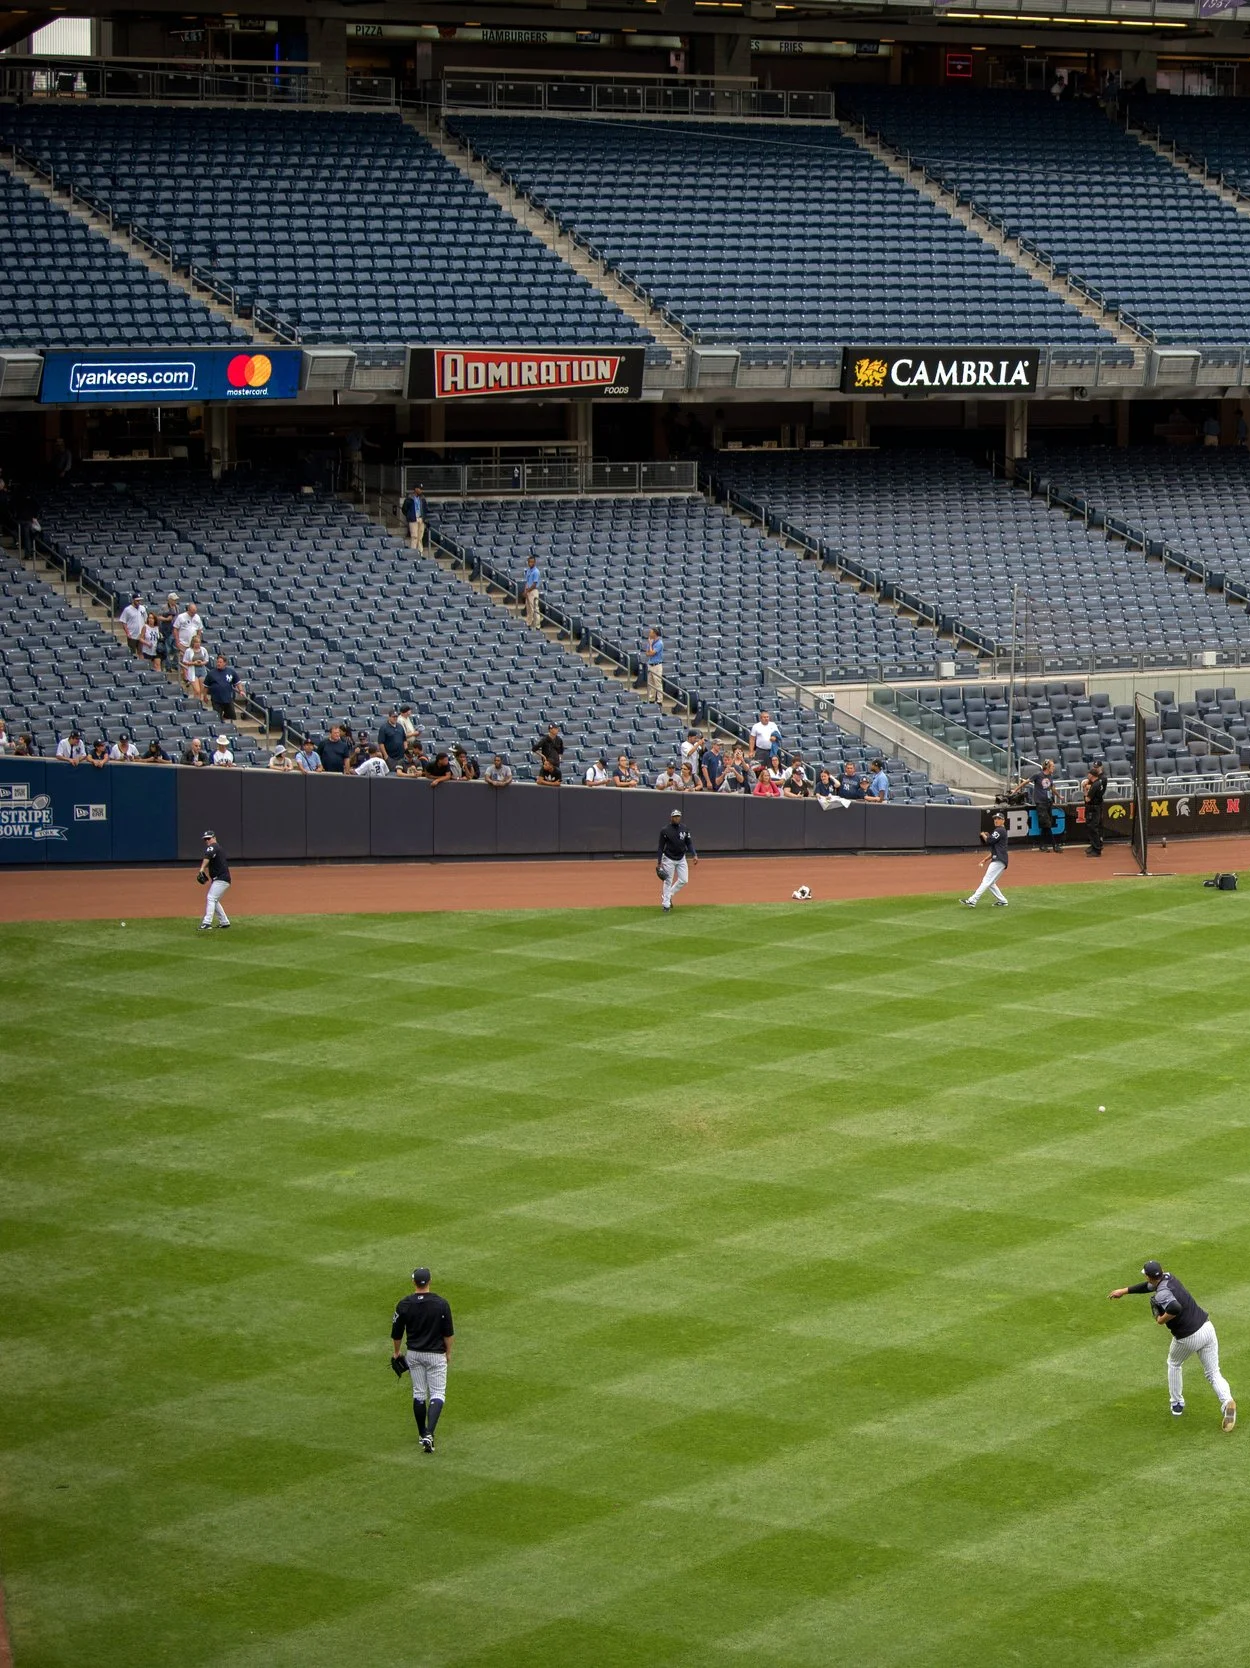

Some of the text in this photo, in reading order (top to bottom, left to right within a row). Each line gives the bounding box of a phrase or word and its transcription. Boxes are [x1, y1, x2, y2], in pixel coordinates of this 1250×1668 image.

[355, 25, 384, 37] PIZZA
[482, 30, 549, 43] HAMBURGERS
[779, 42, 804, 54] FRIES
[75, 368, 190, 389] yankees.com
[443, 353, 612, 392] ADMIRATION
[891, 358, 1031, 386] CAMBRIA
[226, 387, 269, 397] mastercard
[604, 386, 630, 395] FOODS
[0, 809, 50, 824] STRIPE
